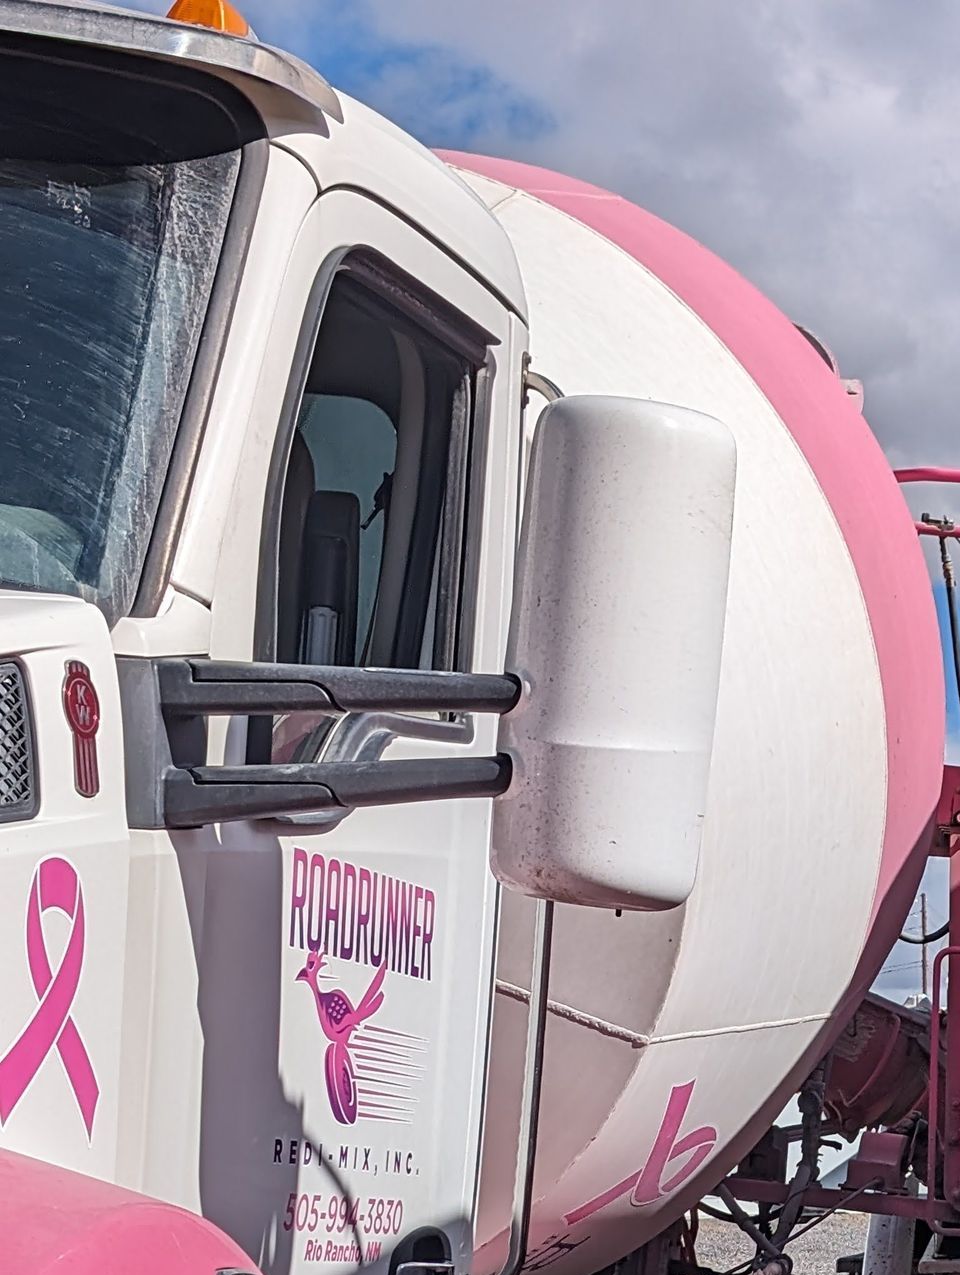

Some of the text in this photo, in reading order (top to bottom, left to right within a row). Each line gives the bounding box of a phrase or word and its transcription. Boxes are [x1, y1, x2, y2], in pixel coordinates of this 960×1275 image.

[289, 846, 436, 982] ROADRUNNER
[273, 1138, 420, 1176] REDI-MIX, INC.
[283, 1192, 404, 1235] 505-994-3830
[304, 1239, 382, 1266] Rio Rancho, NM
